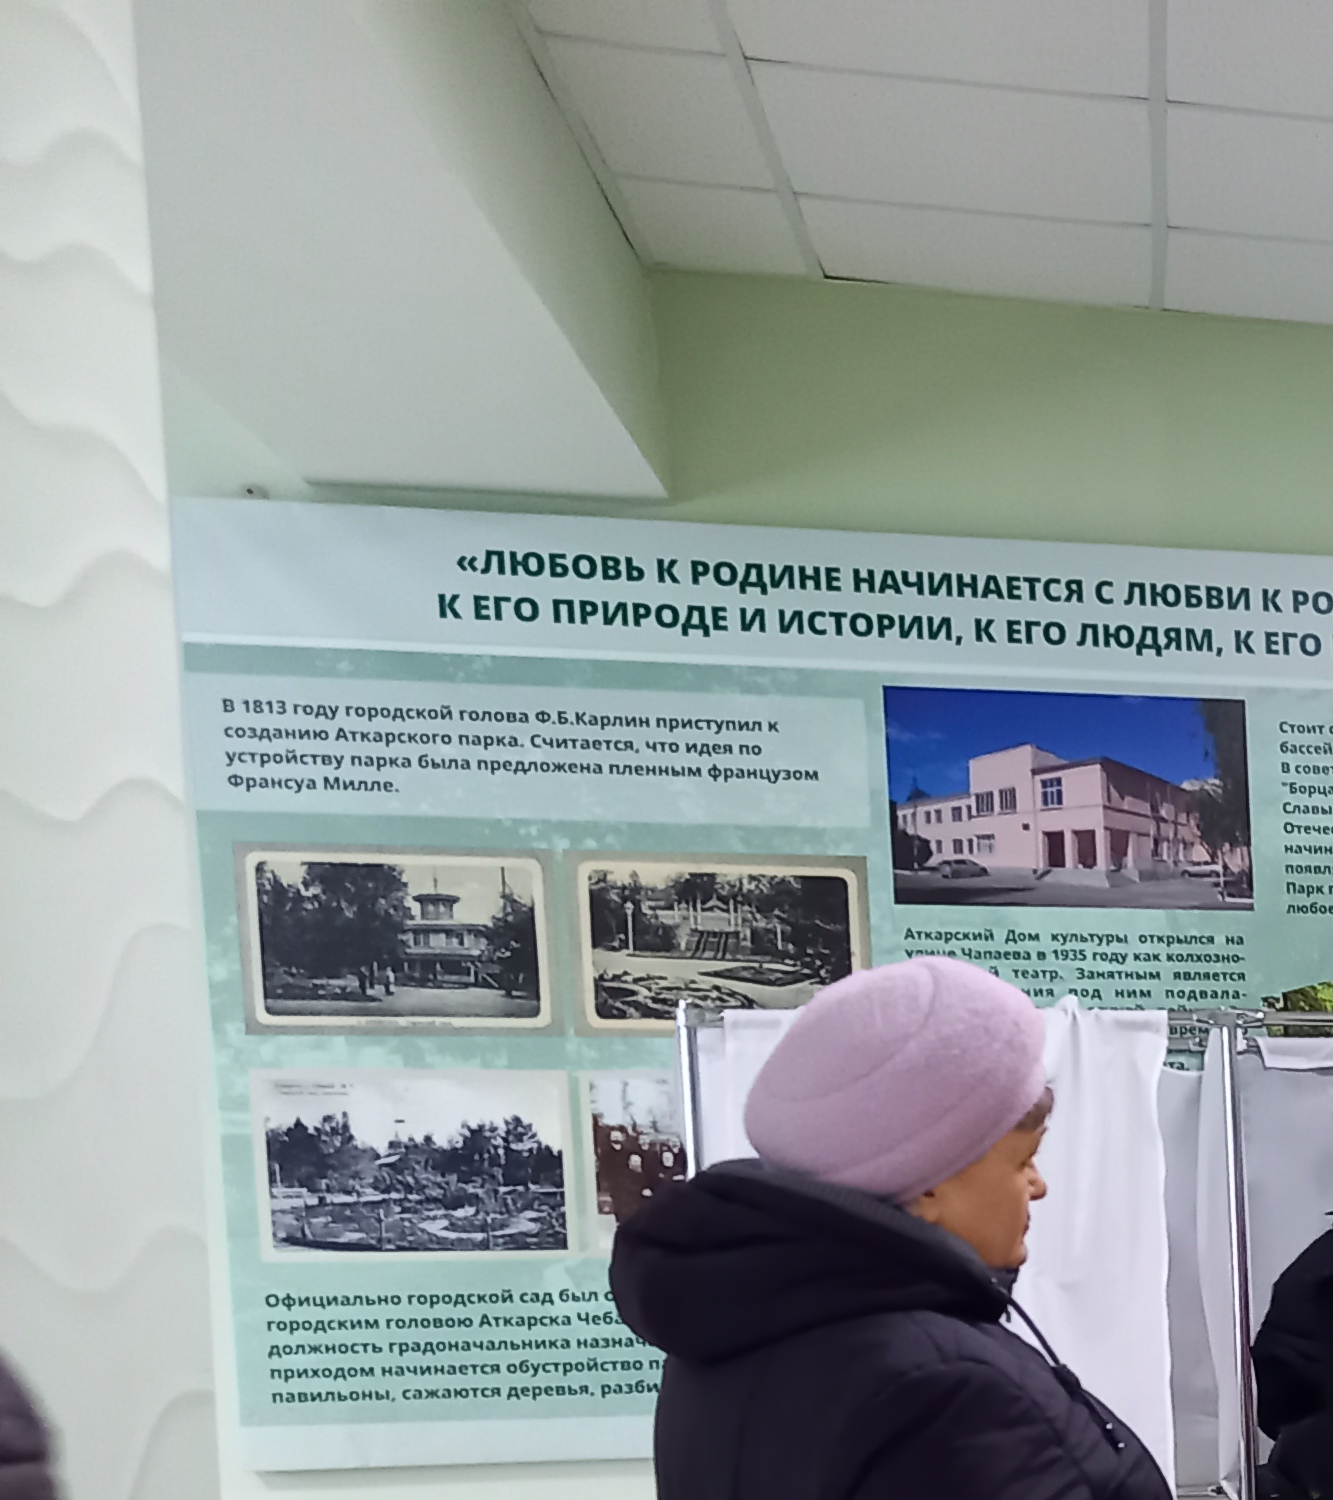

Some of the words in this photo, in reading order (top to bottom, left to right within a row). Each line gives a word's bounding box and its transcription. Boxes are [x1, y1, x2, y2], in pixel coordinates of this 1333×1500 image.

[456, 548, 645, 583] «ЛЮБОВЬ
[656, 557, 681, 586] К
[690, 558, 842, 596] РОДИНЕ
[852, 566, 1084, 605] НАЧИНАЕТСЯ
[1094, 579, 1115, 606] С
[1123, 580, 1251, 612] ЛЮБВИ
[1261, 587, 1283, 615] К
[437, 592, 463, 621] К
[472, 593, 540, 624] ЕГО
[551, 598, 729, 638] ПРИРОДЕ
[739, 606, 767, 634] И
[777, 607, 963, 647] ИСТОРИИ,
[974, 617, 997, 644] К
[1006, 618, 1067, 647] ЕГО
[1076, 622, 1224, 659] ЛЮДЯМ,
[1234, 628, 1256, 655] К
[1264, 630, 1322, 658] ЕГО
[222, 697, 236, 714] В
[242, 698, 287, 716] 1813
[292, 702, 340, 722] году
[344, 704, 454, 723] городской
[458, 708, 530, 725] голова
[534, 709, 651, 732] Ф.Б.Карлин
[655, 716, 763, 736] приступил
[767, 720, 780, 734] к
[223, 725, 330, 744] созданию
[334, 726, 453, 749] Аткарского
[457, 733, 525, 751] парка.
[529, 733, 640, 754] Считается,
[645, 740, 680, 755] что
[684, 741, 734, 759] идея
[738, 743, 763, 757] по
[224, 748, 345, 772] устройству
[350, 754, 412, 773] парка
[417, 752, 472, 771] была
[476, 758, 604, 777] предложена
[608, 763, 703, 778] пленным
[707, 763, 820, 785] французом
[227, 773, 318, 795] Франсуа
[322, 775, 400, 794] Милле.
[903, 927, 995, 945] Аткарский
[1004, 928, 1041, 946] Дом
[1050, 931, 1129, 948] культуры
[1138, 933, 1215, 949] открылся
[1224, 934, 1245, 946] на
[264, 1292, 402, 1312] Официально
[407, 1288, 515, 1310] городской
[519, 1290, 555, 1307] сад
[558, 1287, 599, 1304] был
[266, 1317, 380, 1336] городским
[385, 1316, 474, 1331] головою
[478, 1312, 572, 1332] Аткарска
[267, 1341, 384, 1360] должность
[388, 1337, 571, 1358] градоначальника
[269, 1365, 376, 1384] приходом
[380, 1362, 502, 1378] начинается
[506, 1356, 644, 1379] обустройство
[271, 1388, 396, 1404] павильоны,
[401, 1385, 502, 1401] сажаются
[506, 1383, 595, 1402] деревья,
